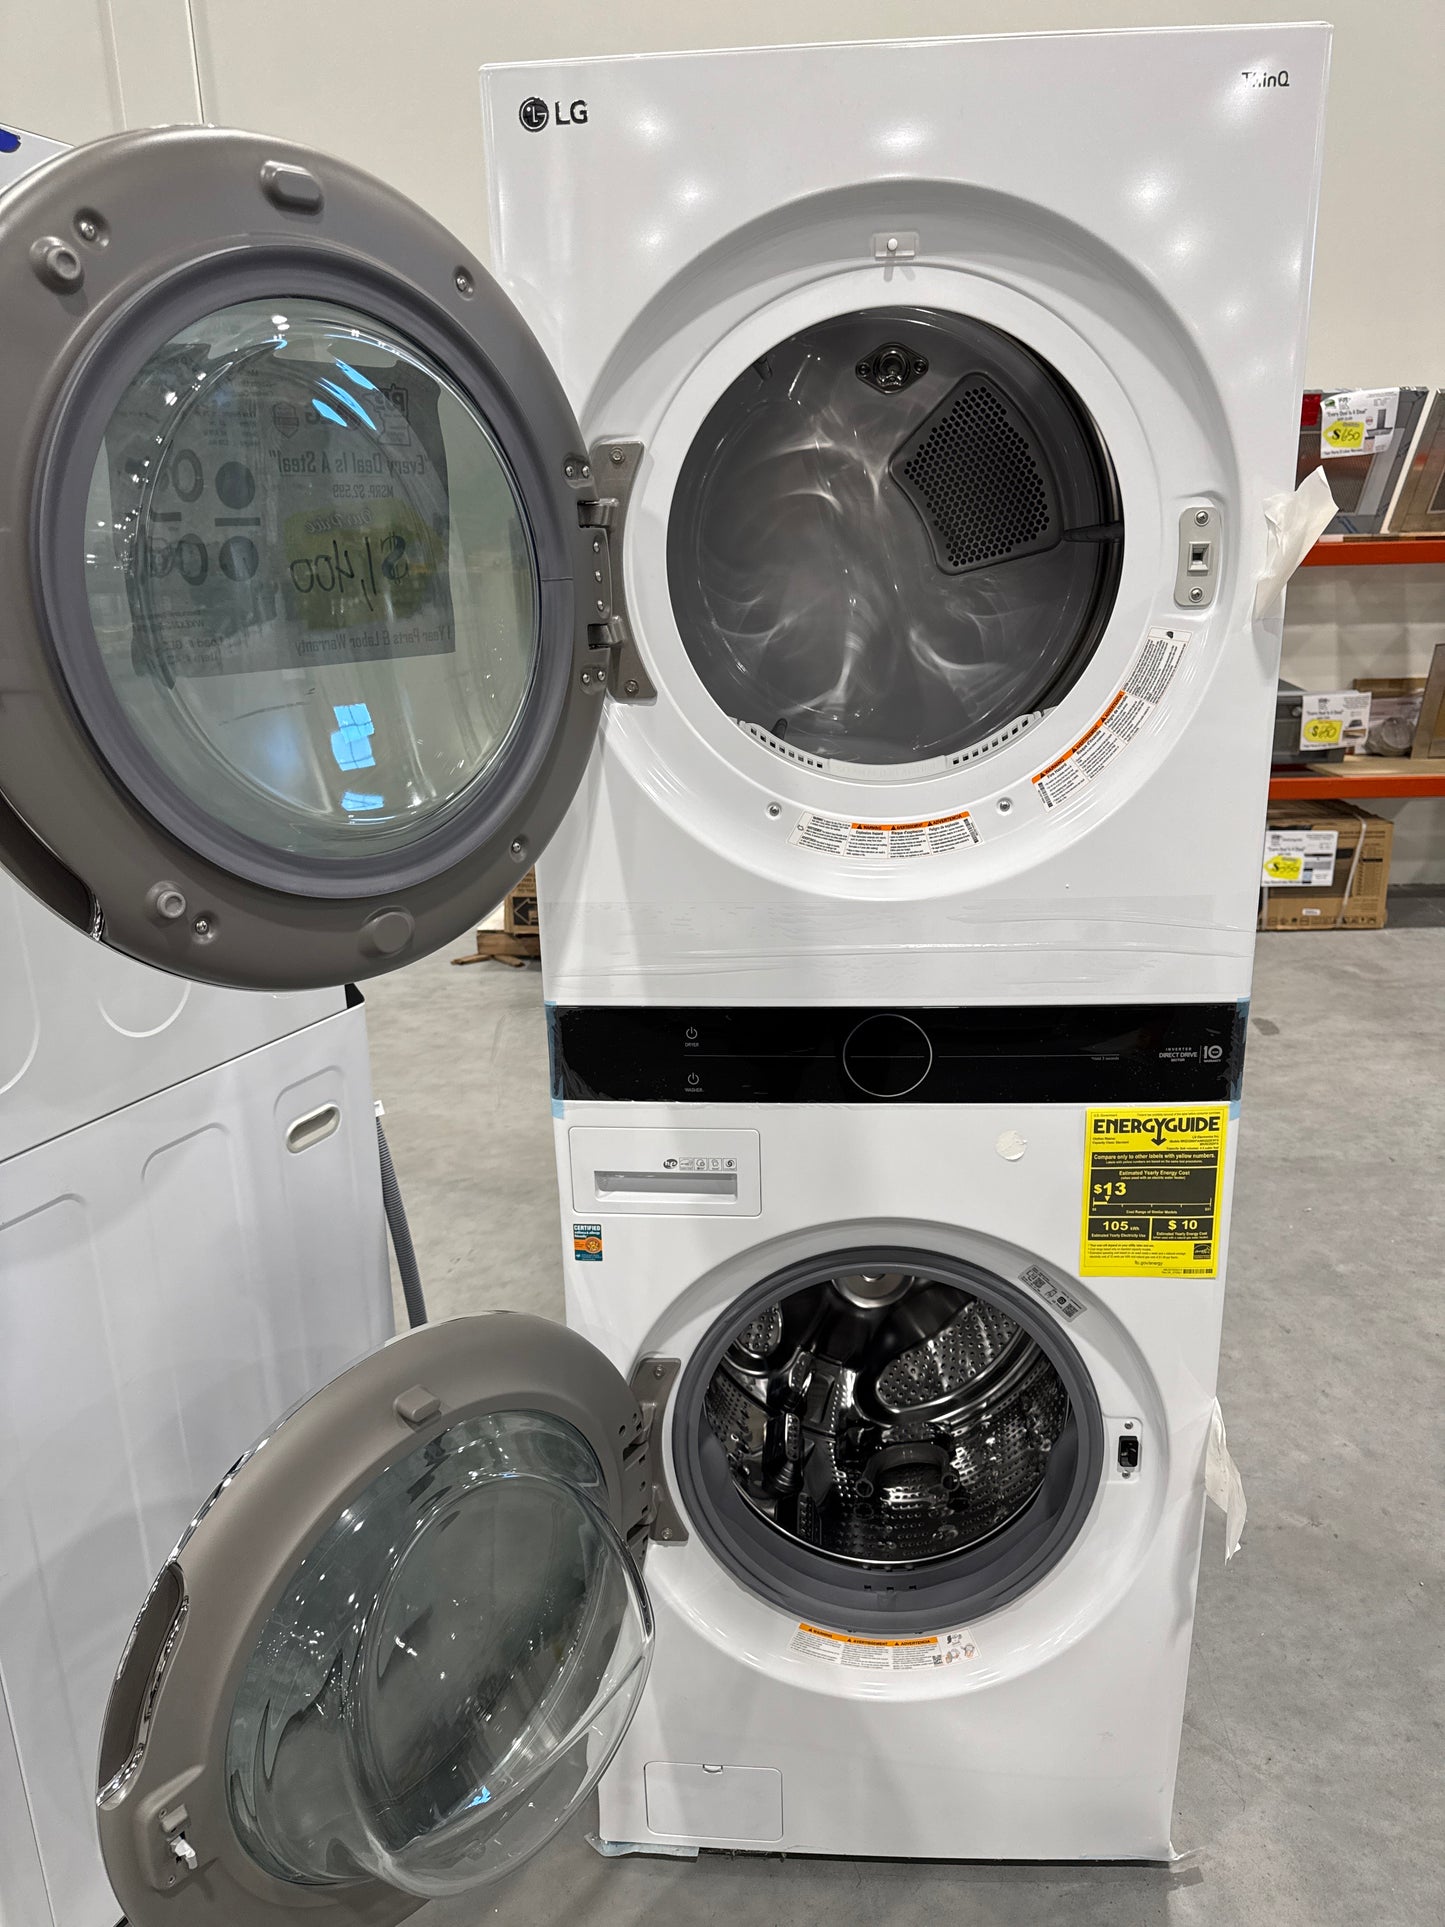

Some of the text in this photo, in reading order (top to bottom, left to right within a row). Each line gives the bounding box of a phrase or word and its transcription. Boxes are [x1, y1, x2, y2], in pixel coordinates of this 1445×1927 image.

[555, 99, 588, 125] LG
[1204, 1045, 1222, 1059] 10
[1093, 1116, 1220, 1138] ENERGYGUIDE
[1093, 1182, 1127, 1196] $13
[1103, 1221, 1128, 1231] 105
[1168, 1220, 1198, 1230] $ 10
